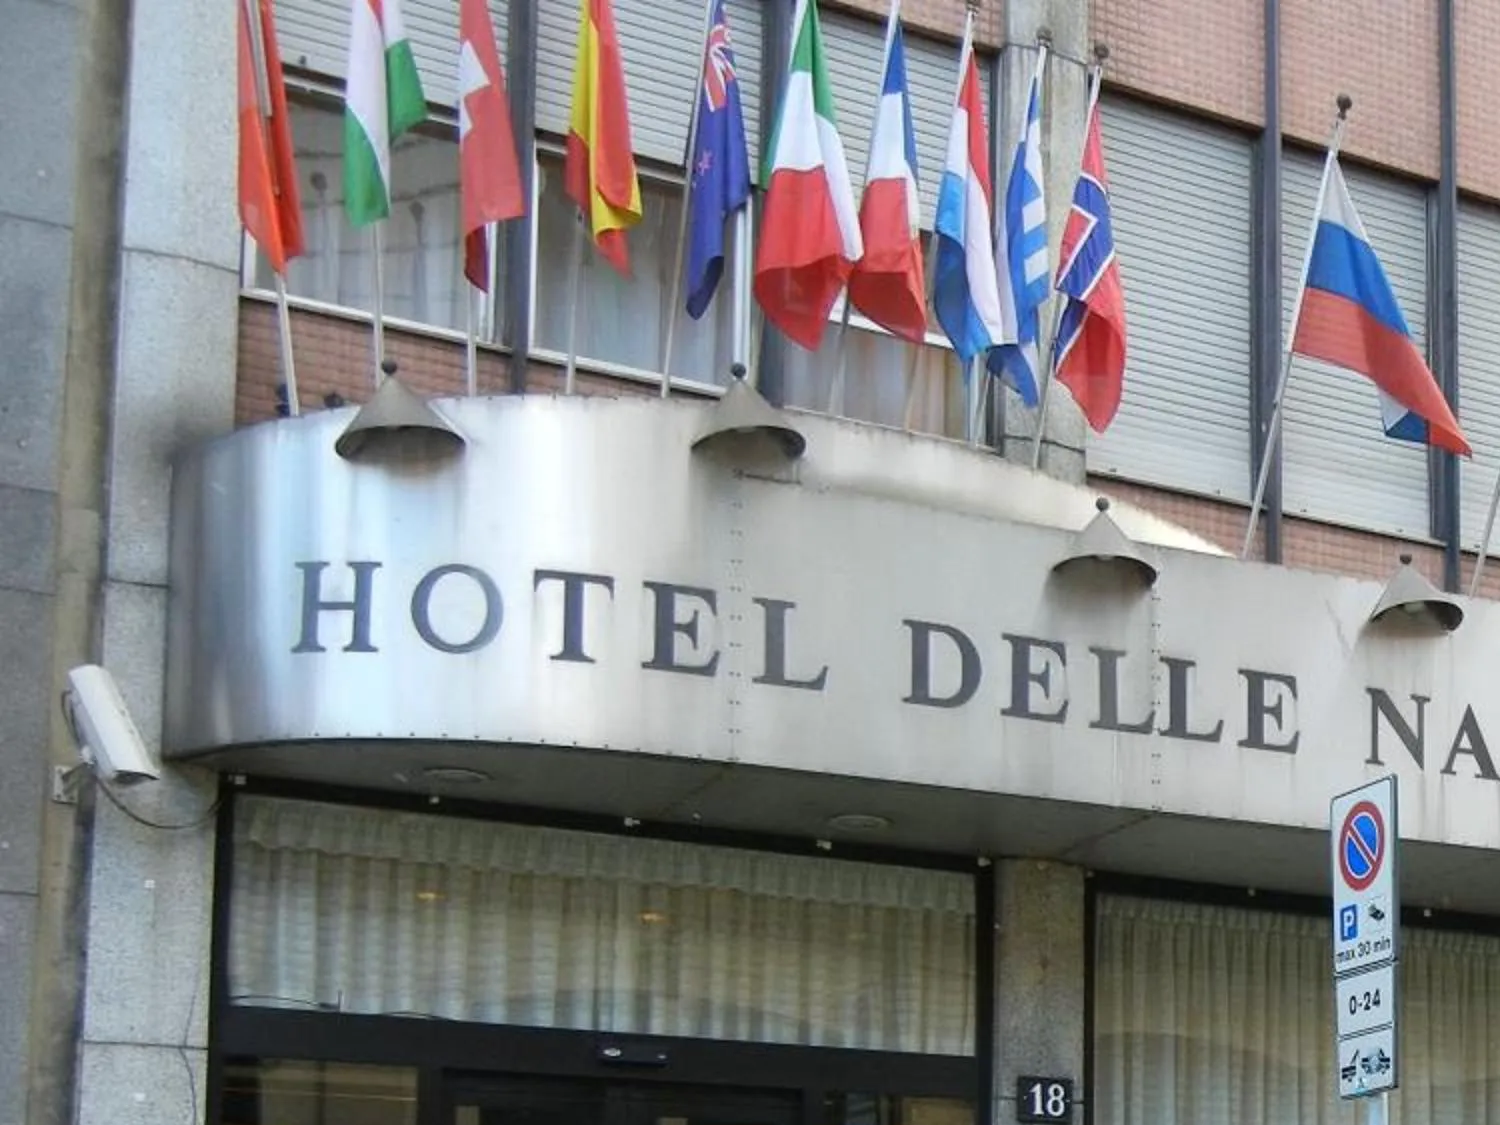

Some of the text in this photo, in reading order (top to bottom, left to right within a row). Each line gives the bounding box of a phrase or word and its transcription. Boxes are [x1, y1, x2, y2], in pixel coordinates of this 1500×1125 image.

[291, 560, 830, 692] HOTEL
[902, 618, 1300, 754] DELLE
[1336, 935, 1390, 963] max 30 min
[1350, 989, 1380, 1015] 0-24
[1030, 1083, 1066, 1117] 18
